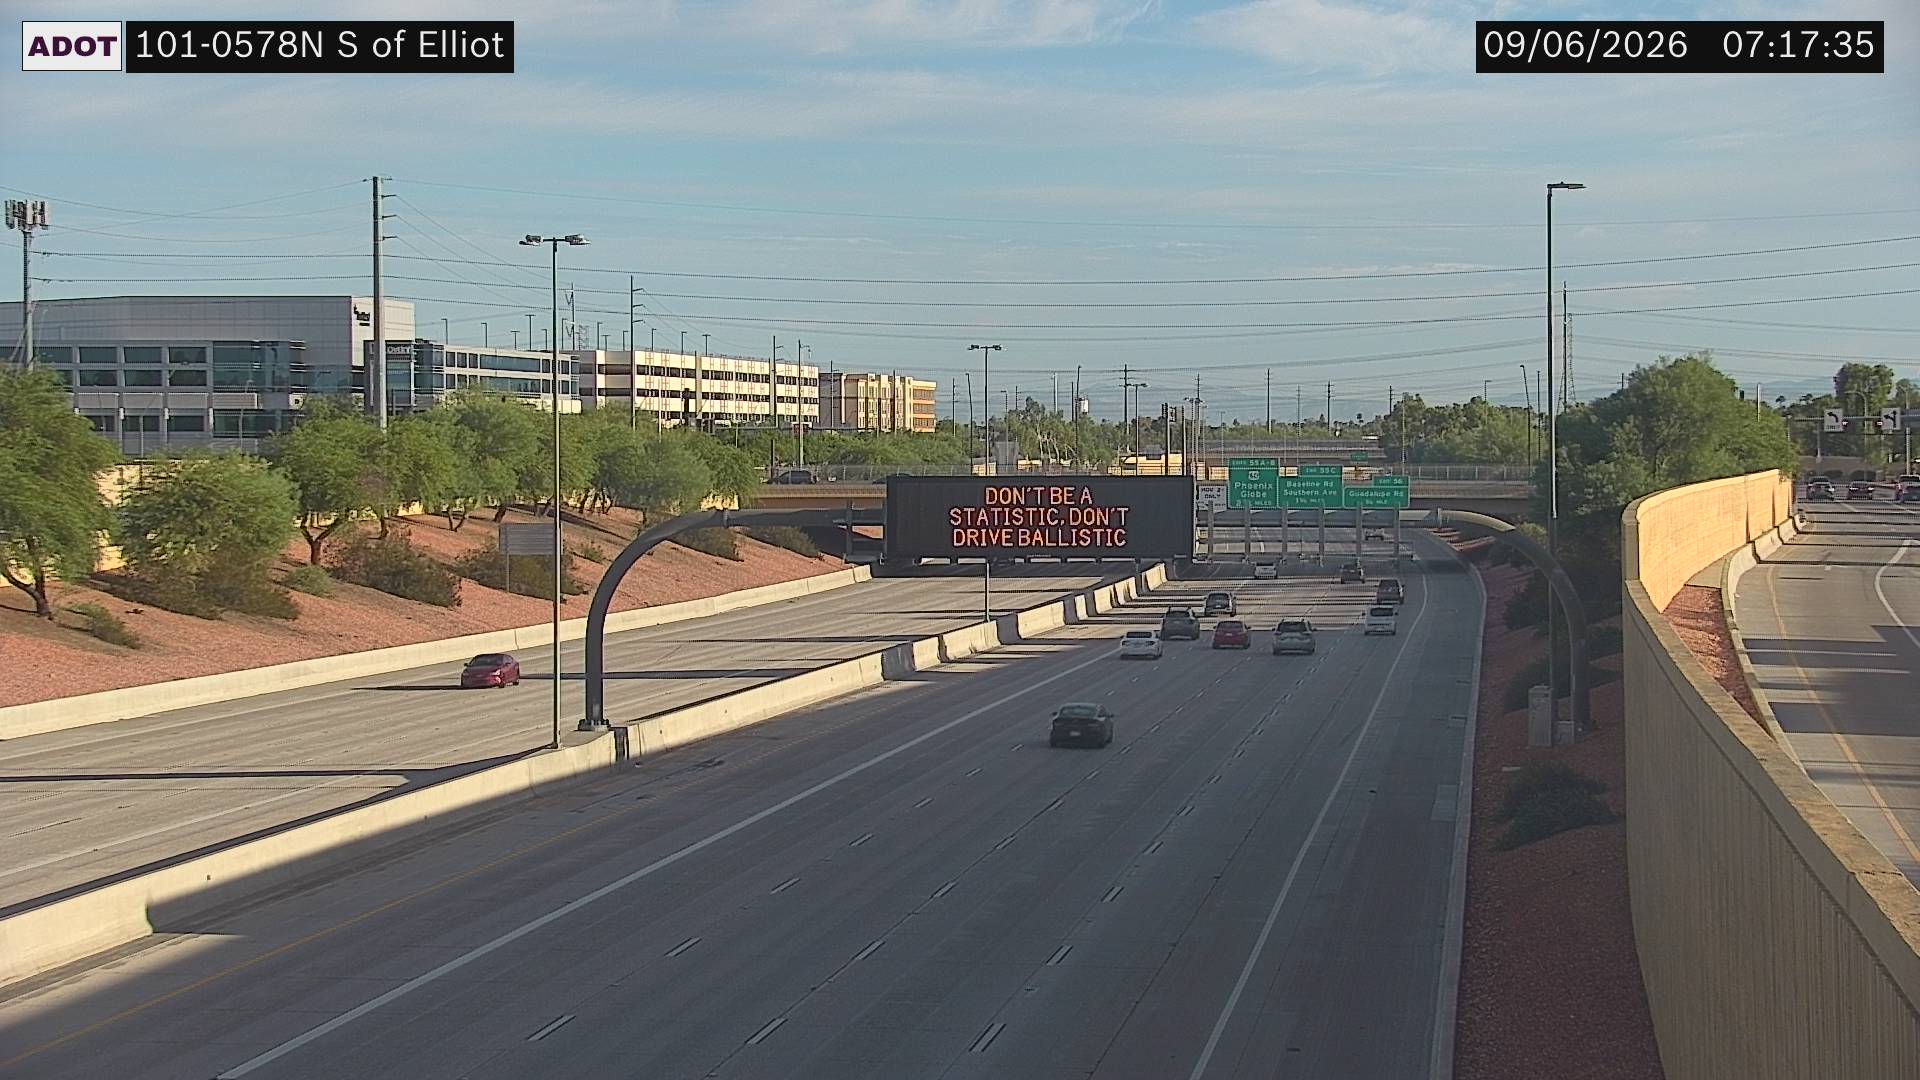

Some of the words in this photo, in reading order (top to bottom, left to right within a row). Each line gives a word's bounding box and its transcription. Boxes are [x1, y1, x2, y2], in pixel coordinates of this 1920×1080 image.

[1234, 482, 1273, 490] Phoenix
[1286, 480, 1320, 488] Baseline
[1323, 480, 1334, 488] Rd
[985, 487, 1045, 505] DON'T
[1050, 487, 1075, 505] BE
[1080, 487, 1093, 505] A
[1240, 490, 1267, 498] Globe
[1283, 489, 1319, 497] Southern
[1349, 490, 1391, 498] Guadalupe
[949, 508, 1065, 527] STATISTIC,
[1069, 508, 1129, 526] DON'T
[953, 529, 1014, 547] DRIVE
[1018, 529, 1127, 547] BALLISTIC
